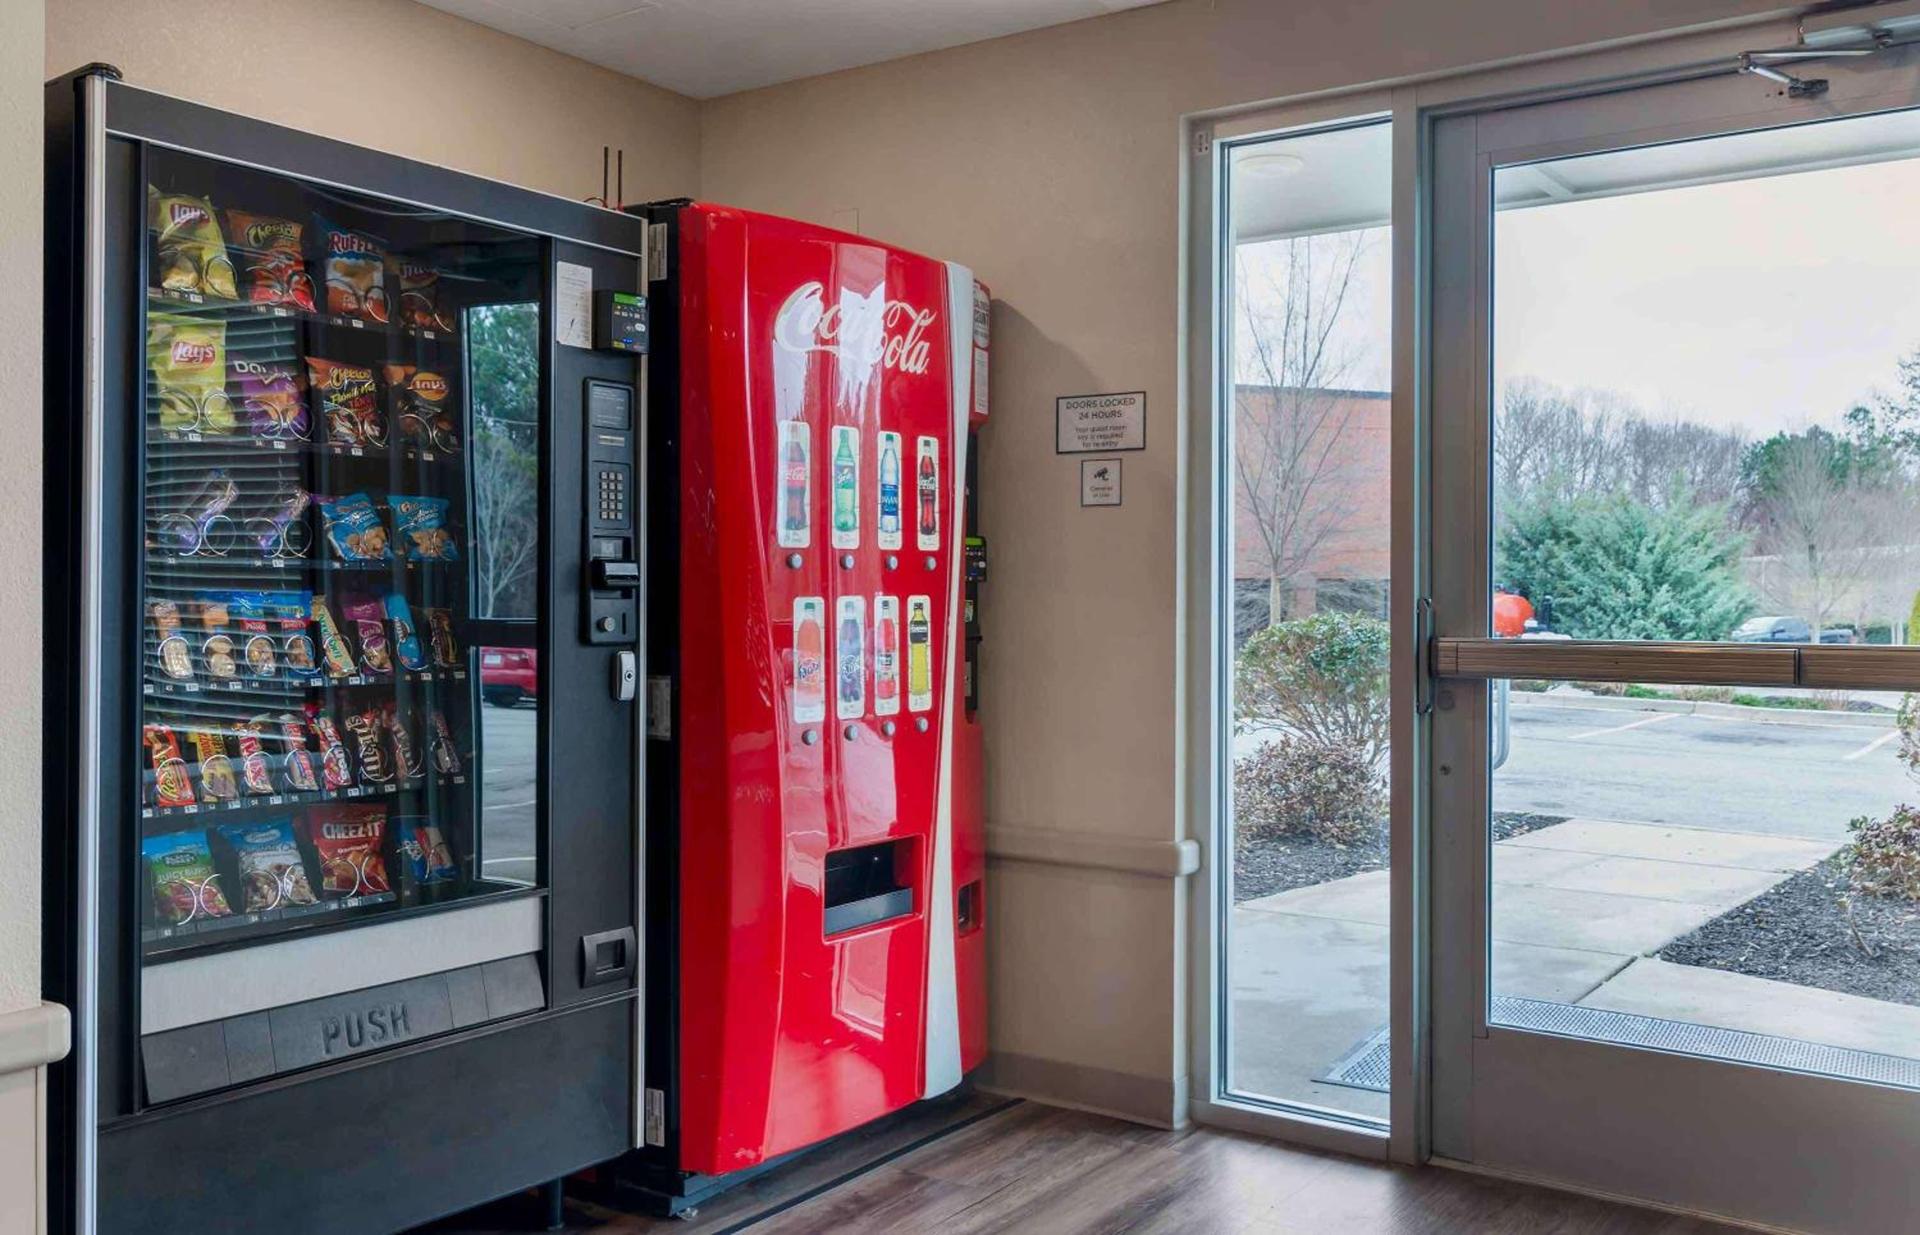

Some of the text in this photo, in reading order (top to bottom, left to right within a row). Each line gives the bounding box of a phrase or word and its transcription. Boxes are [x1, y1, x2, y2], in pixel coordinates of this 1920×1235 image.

[1066, 397, 1136, 409] DOORS LOCKED
[1079, 410, 1122, 420] 24 HOURS
[322, 1004, 410, 1055] PUSH
